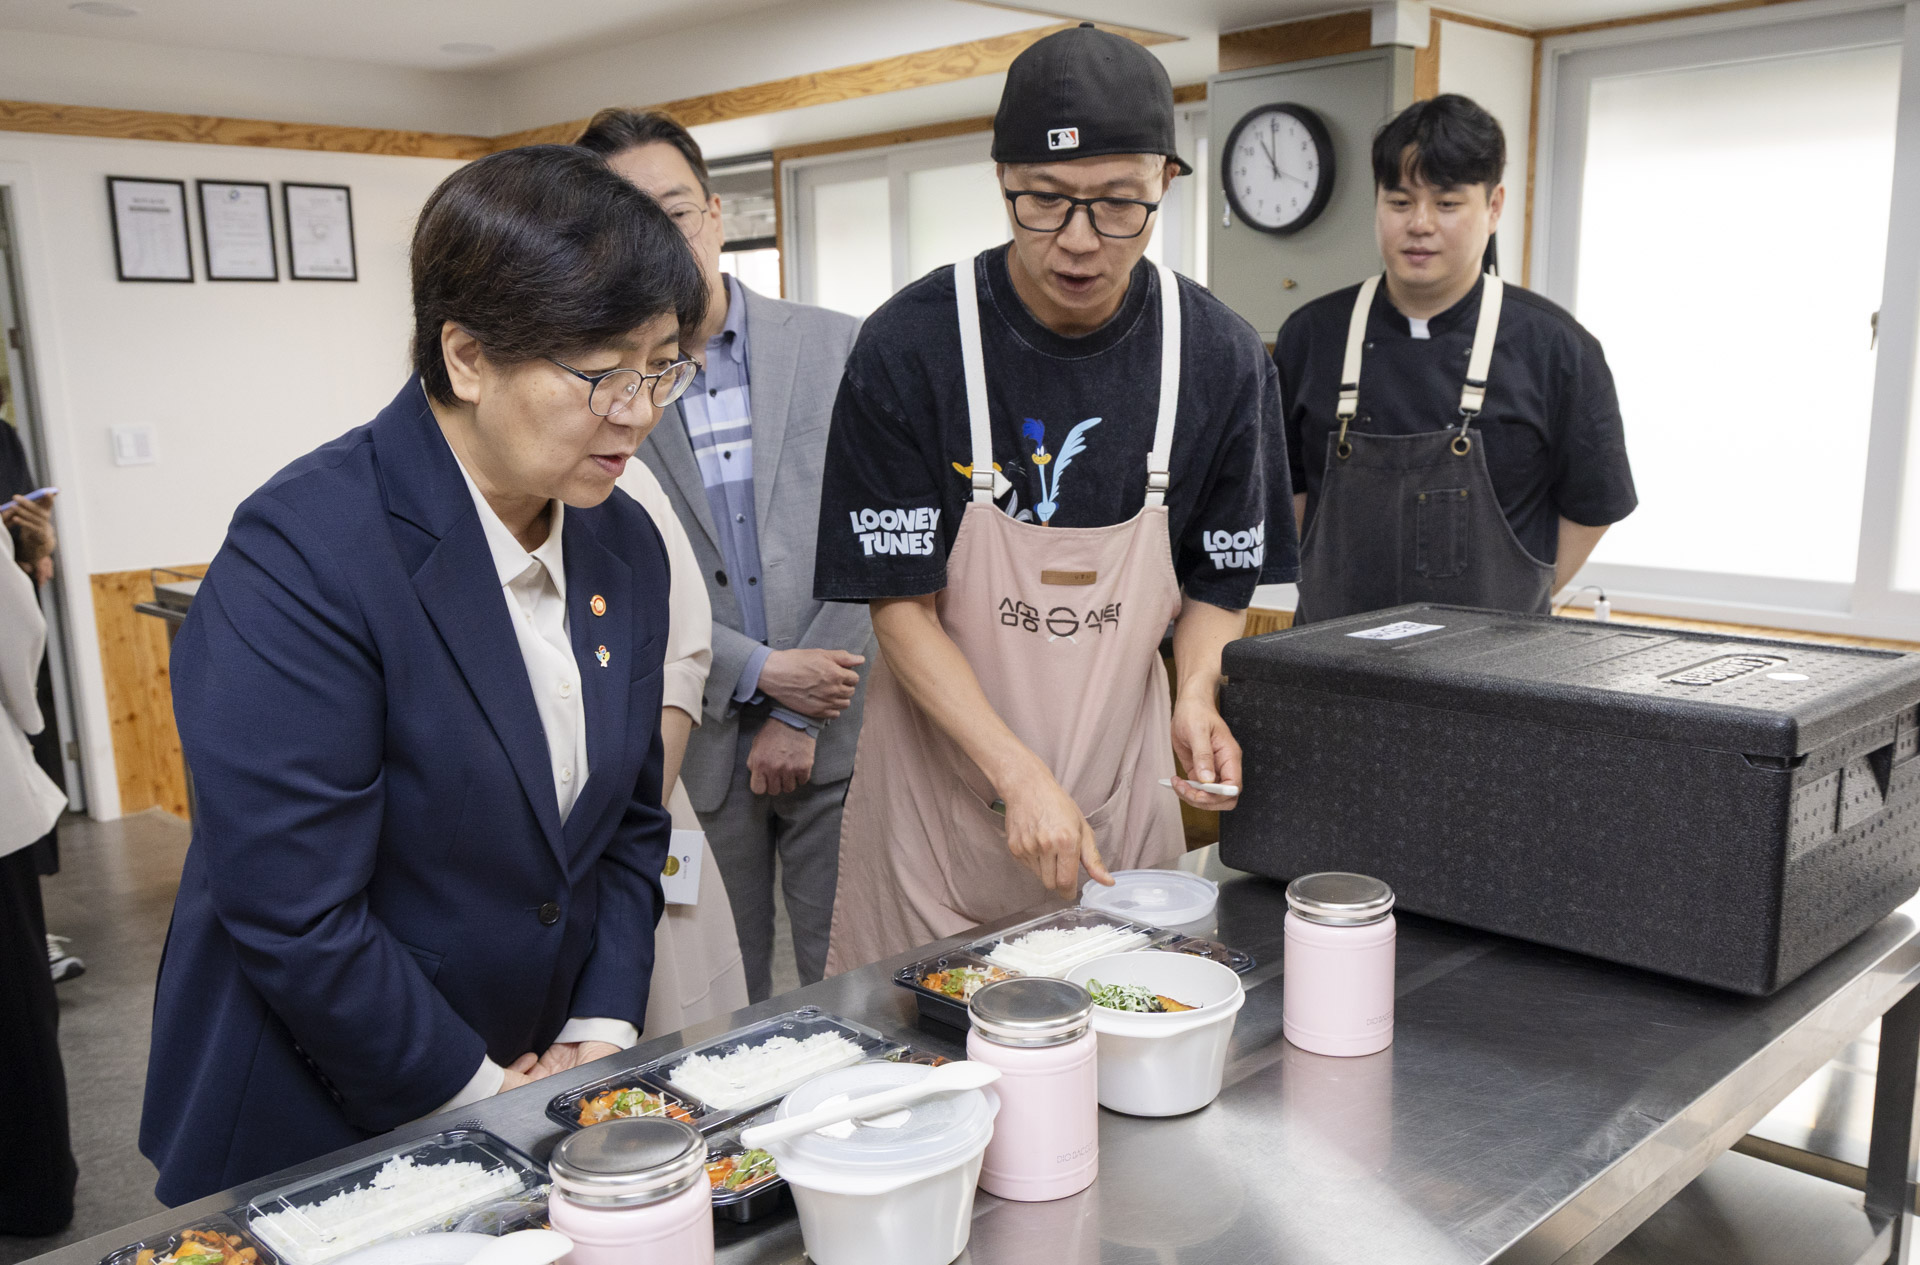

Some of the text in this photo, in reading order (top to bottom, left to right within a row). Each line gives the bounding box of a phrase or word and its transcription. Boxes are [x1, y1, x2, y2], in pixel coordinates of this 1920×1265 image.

[849, 507, 941, 533] LOONEY
[859, 531, 935, 556] TUNES
[1203, 520, 1265, 551] LOON
[1209, 543, 1265, 570] TUN
[1084, 602, 1122, 634] 식탁
